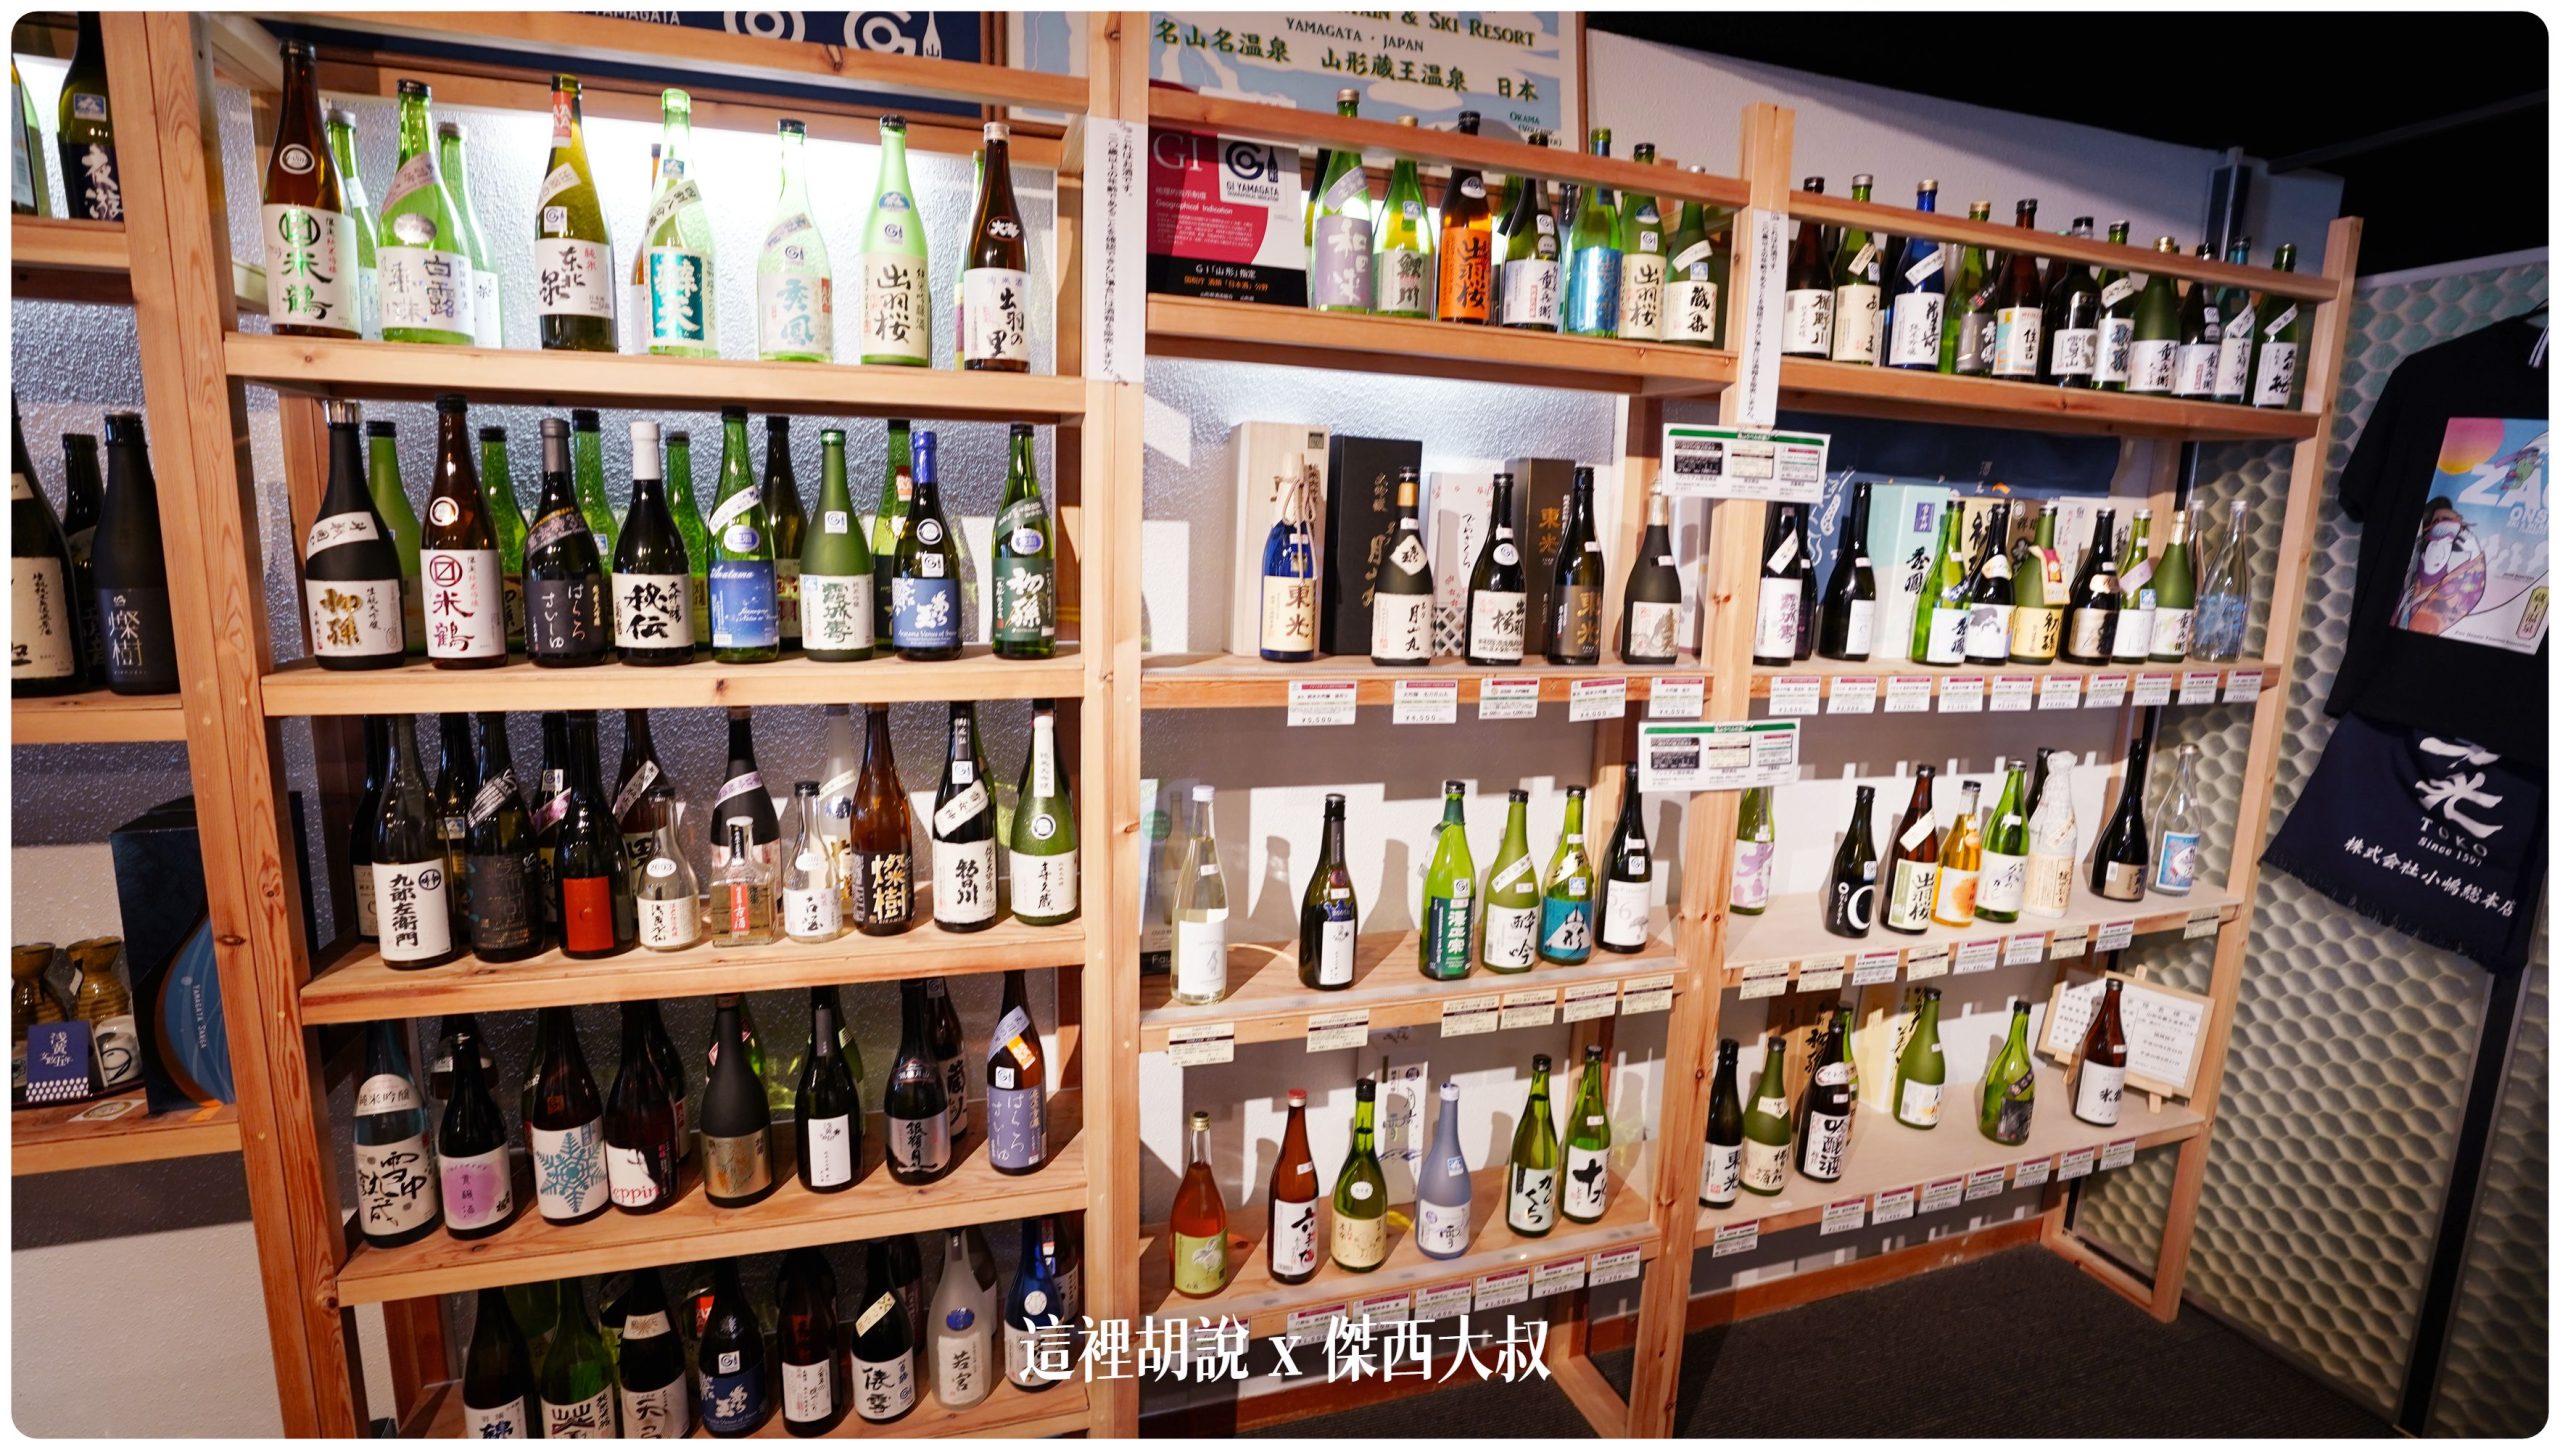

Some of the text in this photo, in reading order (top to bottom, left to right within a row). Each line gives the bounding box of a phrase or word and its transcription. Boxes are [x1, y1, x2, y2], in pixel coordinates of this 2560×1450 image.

[1286, 17, 1424, 52] YAMAGATA JAPAN
[1429, 11, 1459, 33] SKI
[1468, 17, 1536, 47] RESORT
[1155, 18, 1540, 102] 名山名温泉 山形蔵王温泉 日本
[1152, 132, 1203, 172] GI
[1155, 198, 1233, 215] Geographical Indication
[1456, 236, 1489, 310] 出羽桜
[1629, 263, 1661, 329] 出羽桜
[874, 263, 912, 344] 出羽桜
[2457, 463, 2550, 510] ZA
[433, 588, 475, 651] 米鶴
[624, 582, 670, 640] 秘伝
[1285, 585, 1312, 639] 東光
[1405, 602, 1421, 653] 月山丸
[2417, 836, 2451, 856] Since
[389, 873, 419, 947] 九郎左衛門
[871, 852, 907, 920] 燦樹
[1910, 872, 1936, 922] 出羽桜
[1723, 1150, 1742, 1193] 東光
[952, 1349, 970, 1392] 若宮
